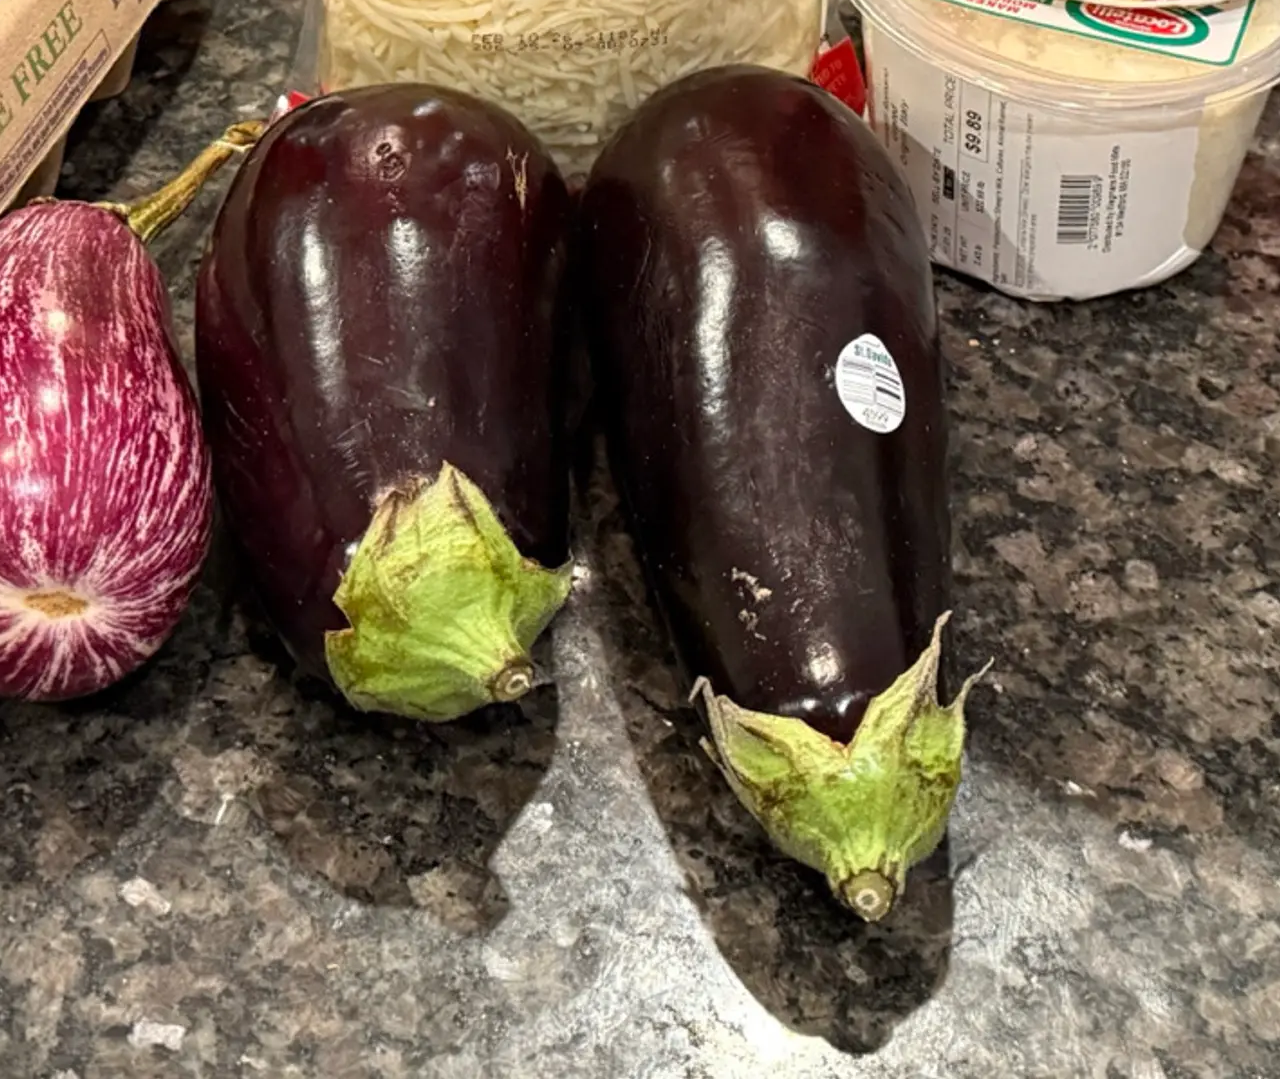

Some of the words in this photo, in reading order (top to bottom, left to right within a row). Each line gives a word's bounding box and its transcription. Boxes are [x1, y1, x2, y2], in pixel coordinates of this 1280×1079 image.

[1091, 6, 1181, 34] Locatelli
[944, 76, 956, 109] PRICE
[943, 113, 955, 145] TOTAL
[965, 109, 983, 155] $9.89
